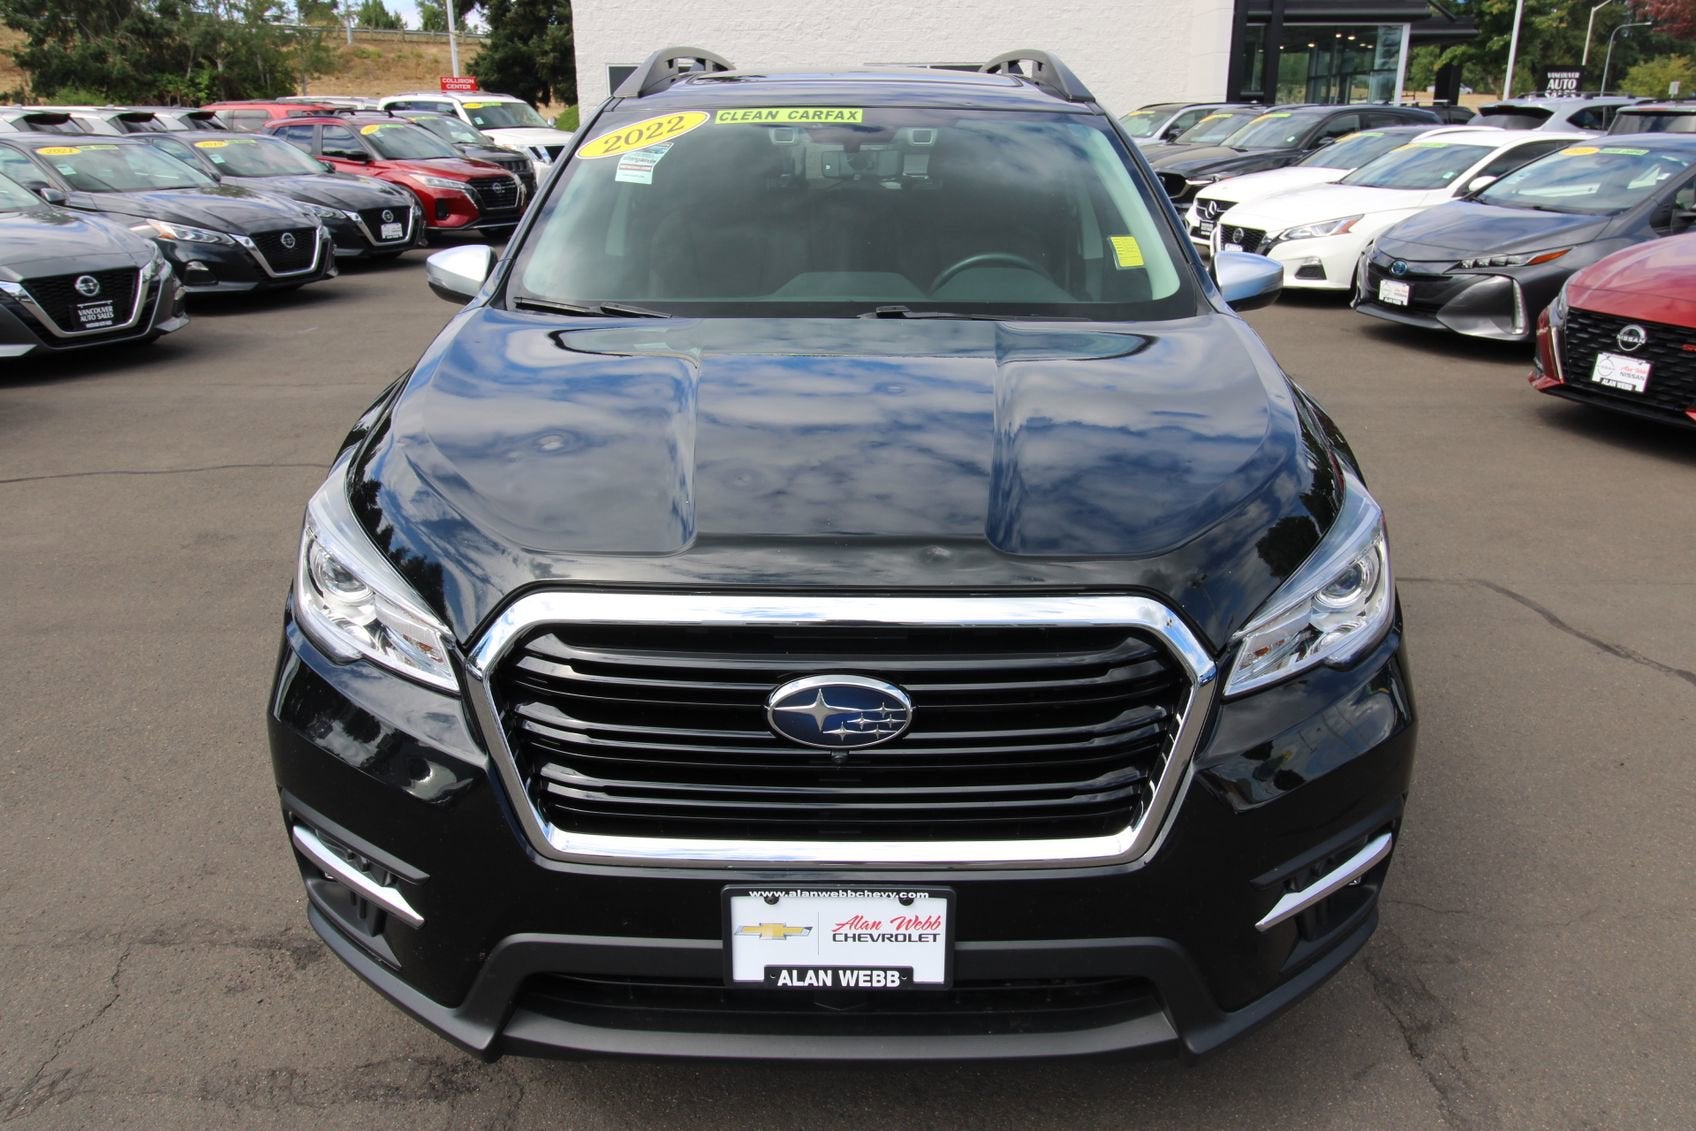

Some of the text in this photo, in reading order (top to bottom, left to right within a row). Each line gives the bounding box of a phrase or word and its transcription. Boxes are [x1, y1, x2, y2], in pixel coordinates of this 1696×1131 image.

[1546, 79, 1577, 90] AUTO
[719, 110, 859, 122] CLEAN CARFAX
[603, 115, 685, 153] 2022
[78, 306, 113, 316] VANCOUVER
[1616, 335, 1647, 344] NISSAN
[1620, 372, 1645, 380] NISSAN
[749, 889, 929, 900] www.alanwebbchevy.com
[832, 914, 942, 933] Alan Webb
[832, 933, 941, 943] CHEVROLET
[777, 970, 900, 988] ALAN WEBB
